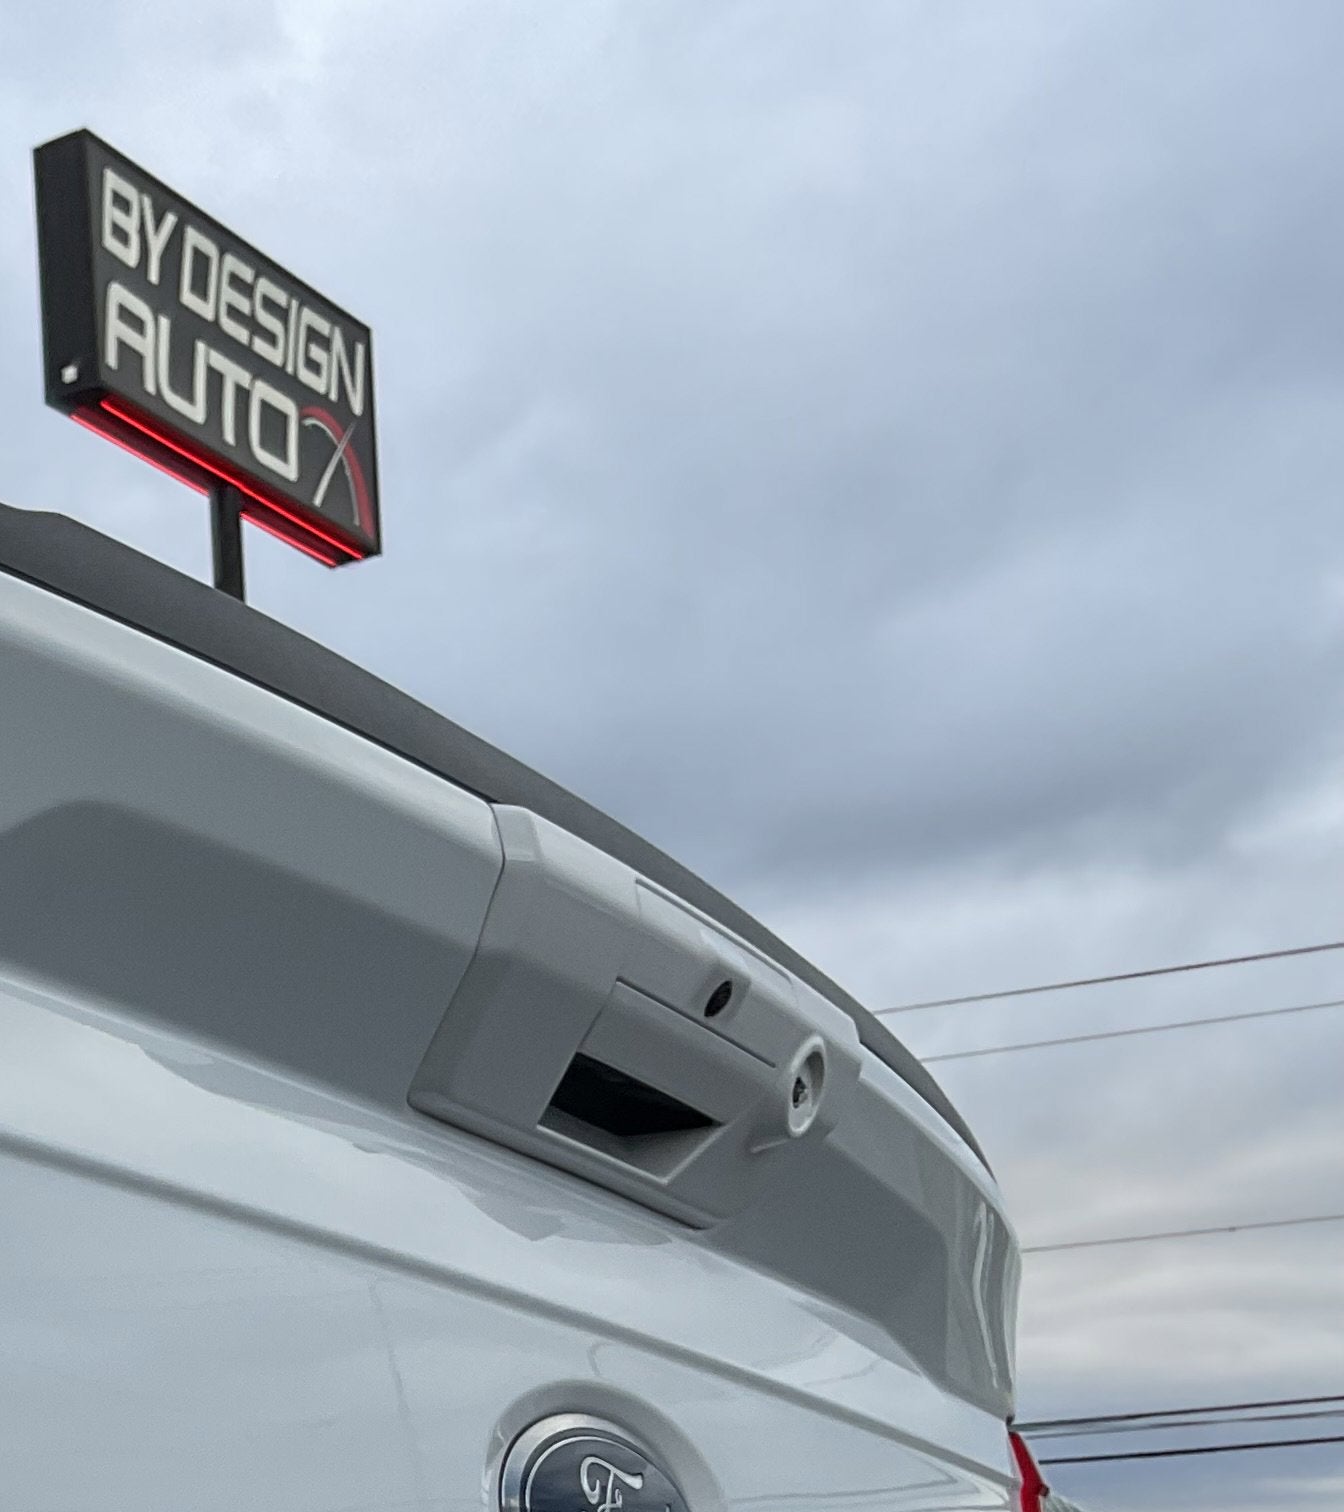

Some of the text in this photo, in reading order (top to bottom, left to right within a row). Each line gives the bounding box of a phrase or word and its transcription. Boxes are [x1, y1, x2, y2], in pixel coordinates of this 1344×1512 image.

[101, 168, 365, 417] BY DESIGN
[105, 280, 299, 482] AUTO
